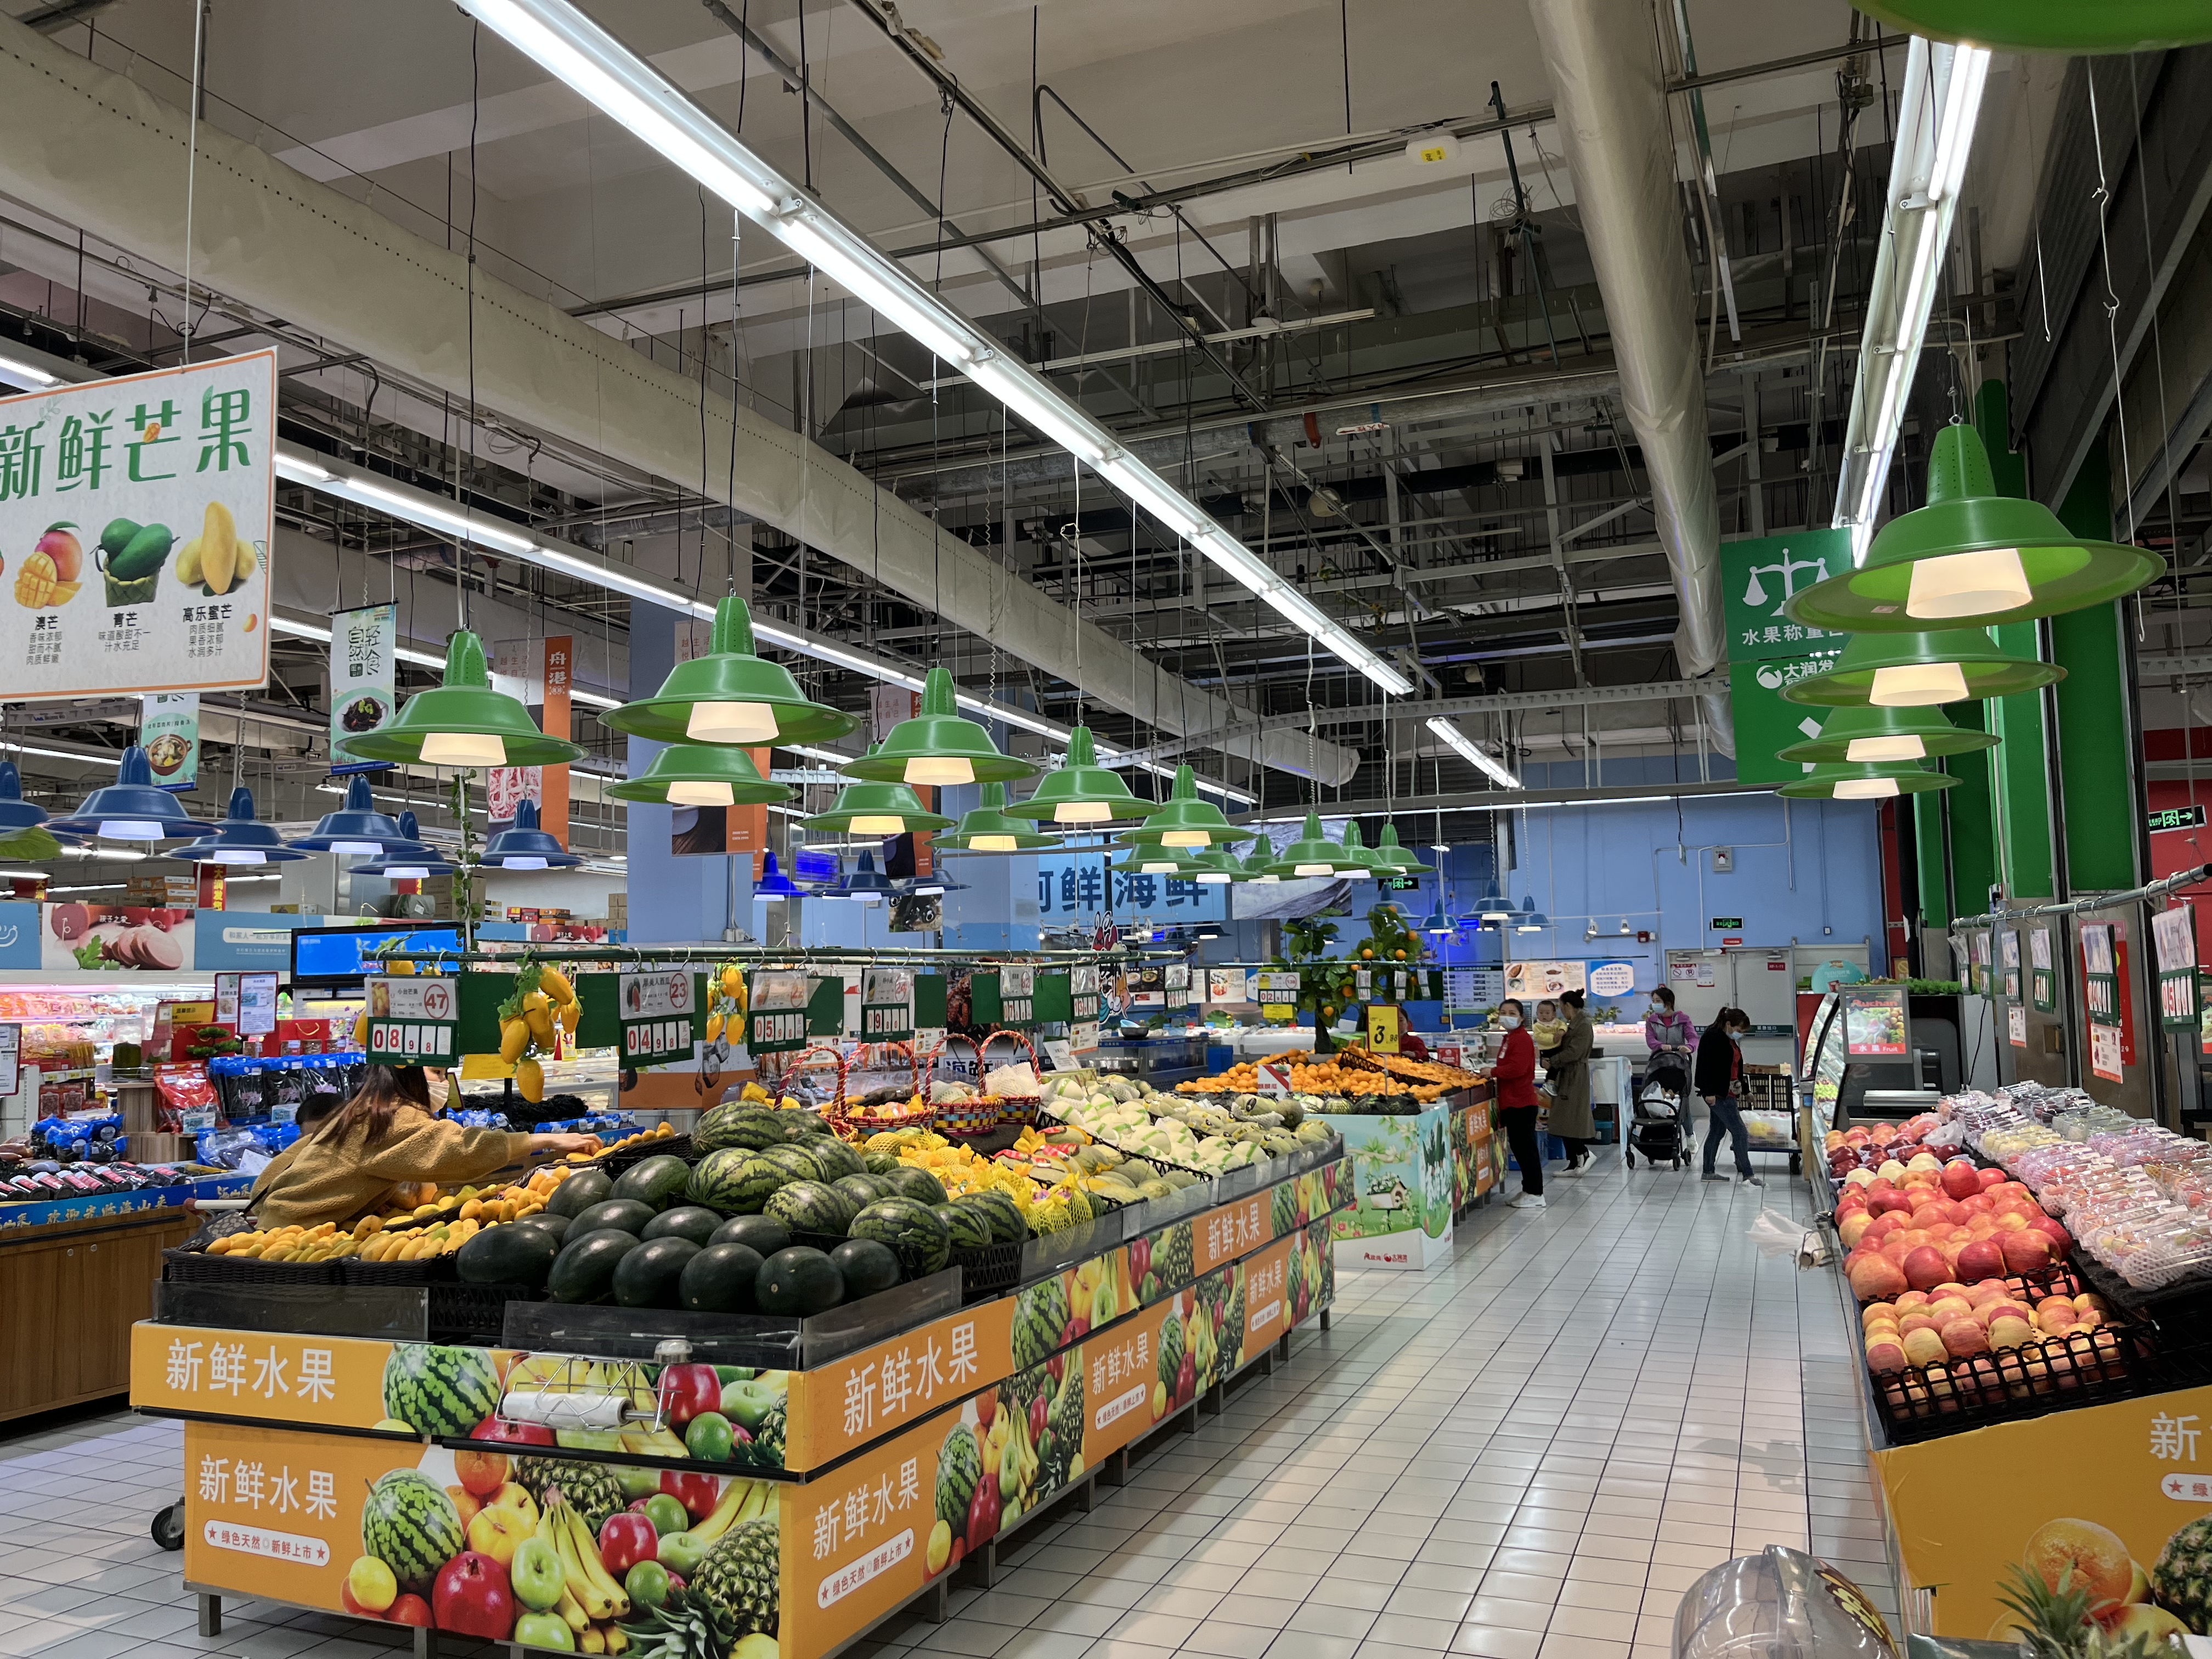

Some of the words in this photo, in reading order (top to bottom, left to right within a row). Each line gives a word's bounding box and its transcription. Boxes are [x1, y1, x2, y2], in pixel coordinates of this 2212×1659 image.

[0, 385, 253, 501] 新鲜芒果
[114, 611, 138, 628] 青芒
[183, 603, 232, 623] 高乐蜜芒
[98, 629, 151, 641] 味道酸甜不一
[189, 633, 224, 646] 果香浓郁
[190, 622, 224, 635] 肉质细腻
[104, 640, 140, 652] 汁水充足
[187, 645, 223, 658] 水润多汁
[348, 626, 364, 662] 自然
[365, 624, 382, 675] 轻食
[549, 651, 567, 684] 舟港
[1784, 659, 1834, 678] 大润发
[425, 994, 448, 1009] 47
[670, 982, 686, 998] 23
[1850, 998, 1898, 1008] Auchan
[1374, 1025, 1385, 1044] 3
[1207, 1202, 1260, 1261] 新鲜水果
[1249, 1259, 1283, 1305] 新鲜水果
[166, 1338, 336, 1403] 新鲜水果
[1092, 1331, 1149, 1395] 新鲜水果
[843, 1320, 978, 1437] 新鲜水果
[2149, 1411, 2212, 1462] 新
[199, 1454, 337, 1520] 新鲜水果
[2192, 1482, 2212, 1497] 绿
[812, 1457, 920, 1561] 新鲜水果
[221, 1528, 261, 1550] 绿色天然
[271, 1539, 312, 1560] 新鲜上市
